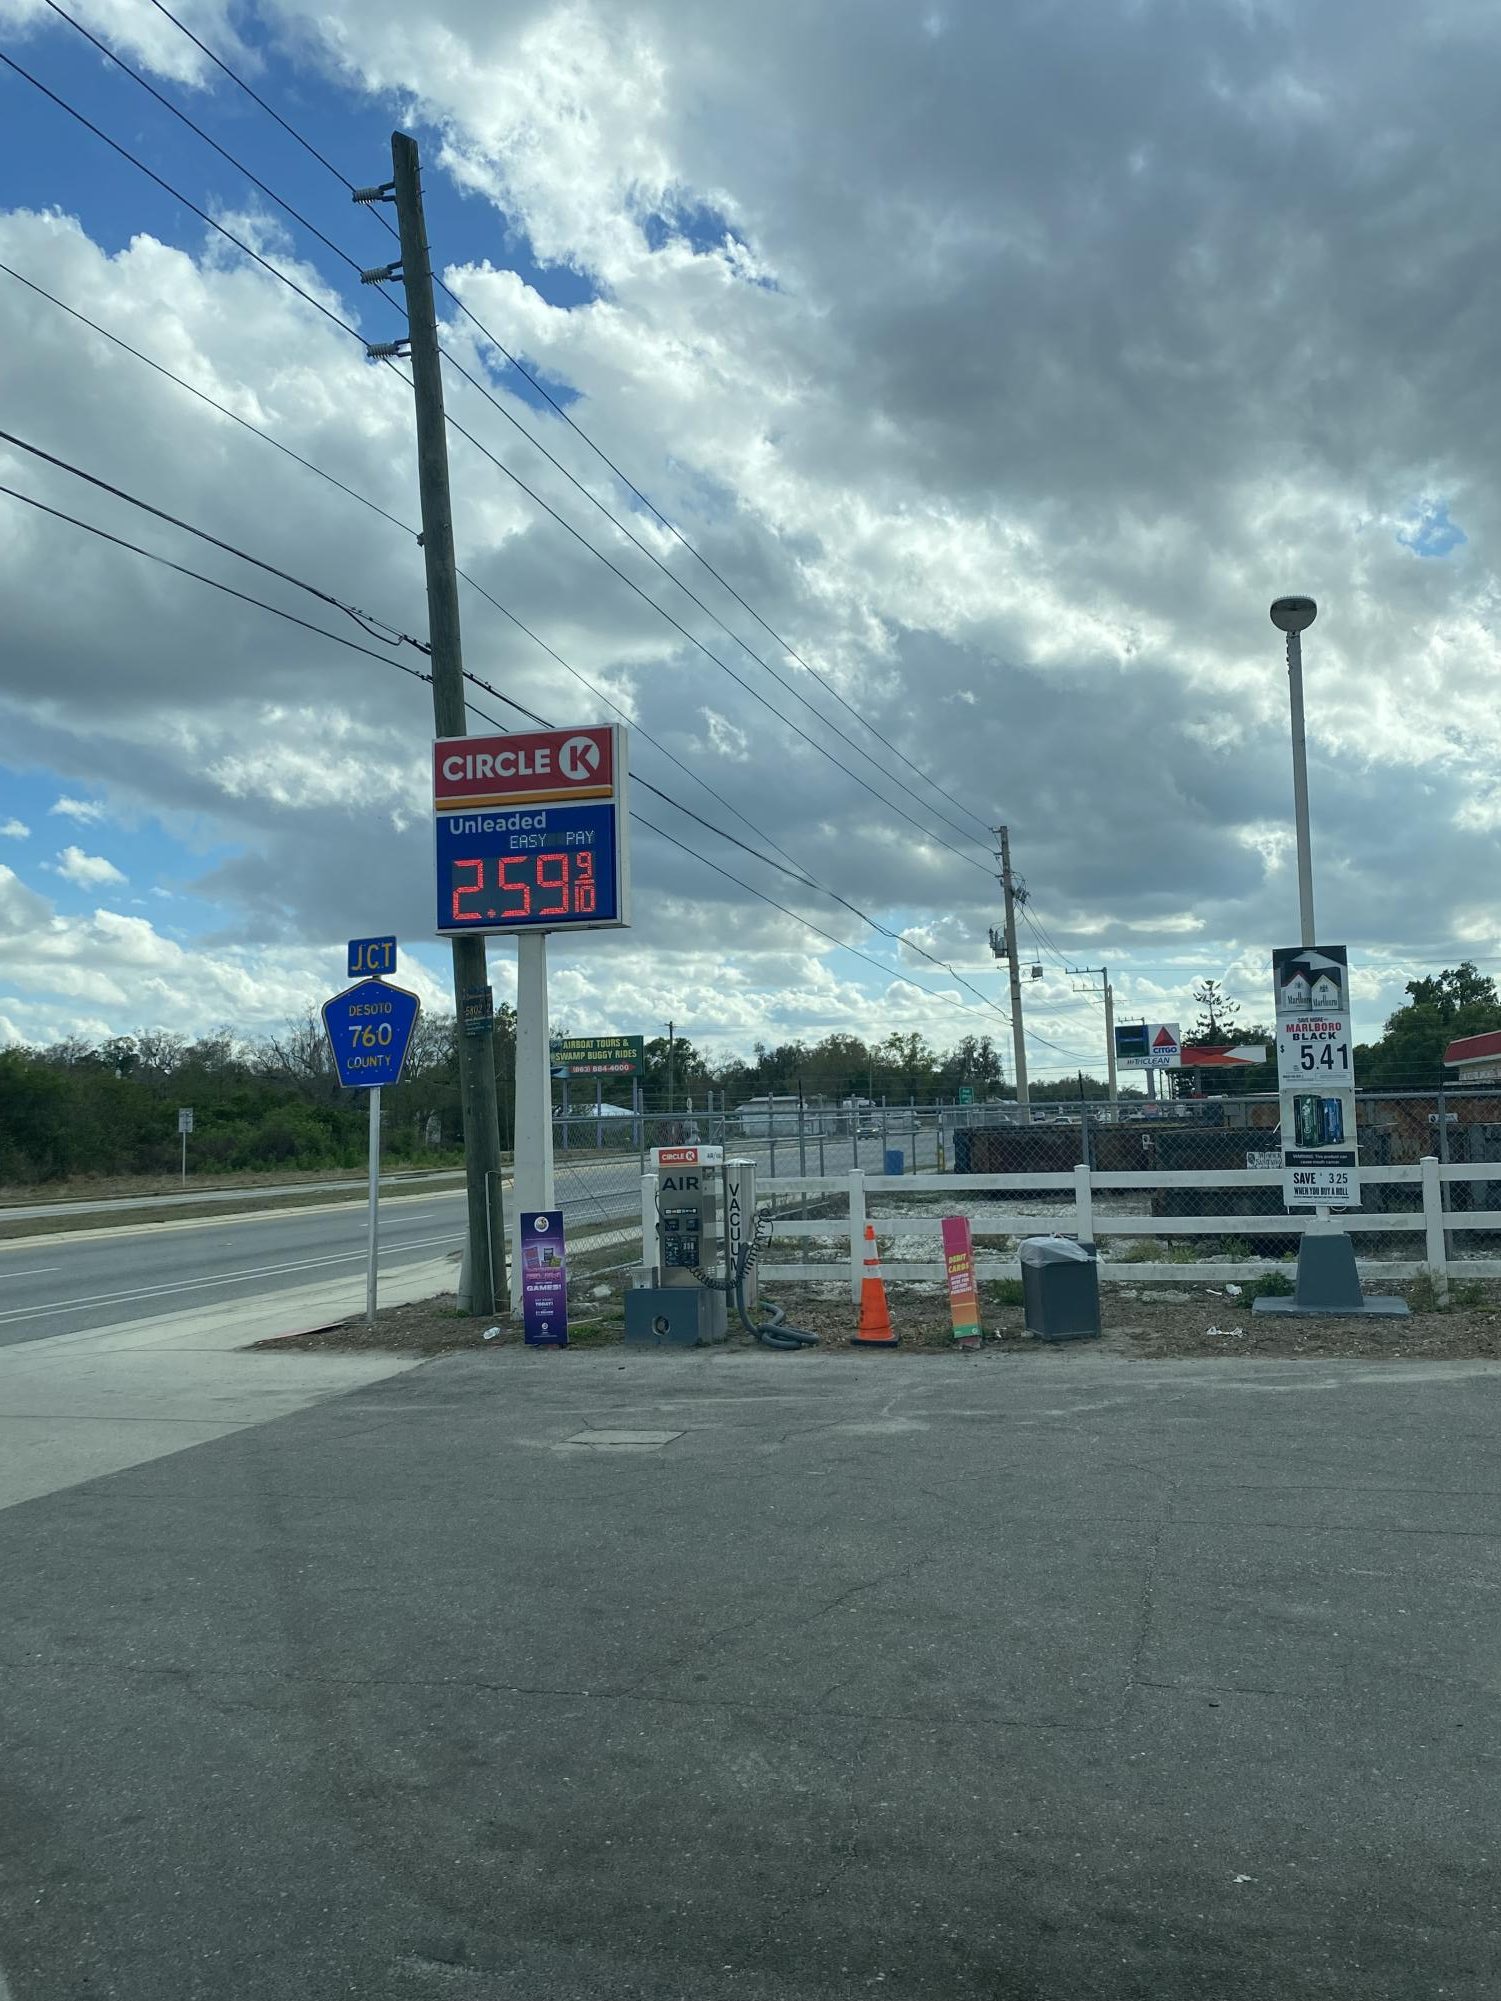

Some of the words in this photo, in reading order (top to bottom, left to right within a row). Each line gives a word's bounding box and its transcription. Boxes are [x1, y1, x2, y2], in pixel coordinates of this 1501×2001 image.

[442, 748, 551, 781] CIRCLE
[565, 739, 598, 780] K
[450, 811, 547, 835] Unleaded
[510, 833, 547, 849] EASY
[566, 830, 595, 846] PAY
[452, 853, 569, 920] 2.59
[351, 943, 393, 971] JCT
[349, 1002, 392, 1017] DESOTO
[1286, 1022, 1342, 1033] MARLBORO
[348, 1022, 393, 1048] 760
[1292, 1031, 1337, 1041] BLACK
[562, 1039, 594, 1050] AIRBOAT
[596, 1038, 621, 1048] TOURS
[622, 1038, 629, 1047] &
[347, 1054, 391, 1069] COUNTY
[555, 1051, 586, 1061] SWAMP
[587, 1050, 613, 1060] BUGGY
[615, 1048, 637, 1058] RIDES
[1300, 1043, 1349, 1071] 5.41
[661, 1153, 685, 1161] CIRCLE
[686, 1151, 695, 1161] K
[662, 1176, 700, 1191] AIR
[1293, 1172, 1316, 1185] SAVE
[1293, 1186, 1309, 1196] WHEN
[949, 1254, 966, 1264] DEBIT
[949, 1263, 969, 1273] CARDS
[526, 1283, 562, 1292] GAMES!
